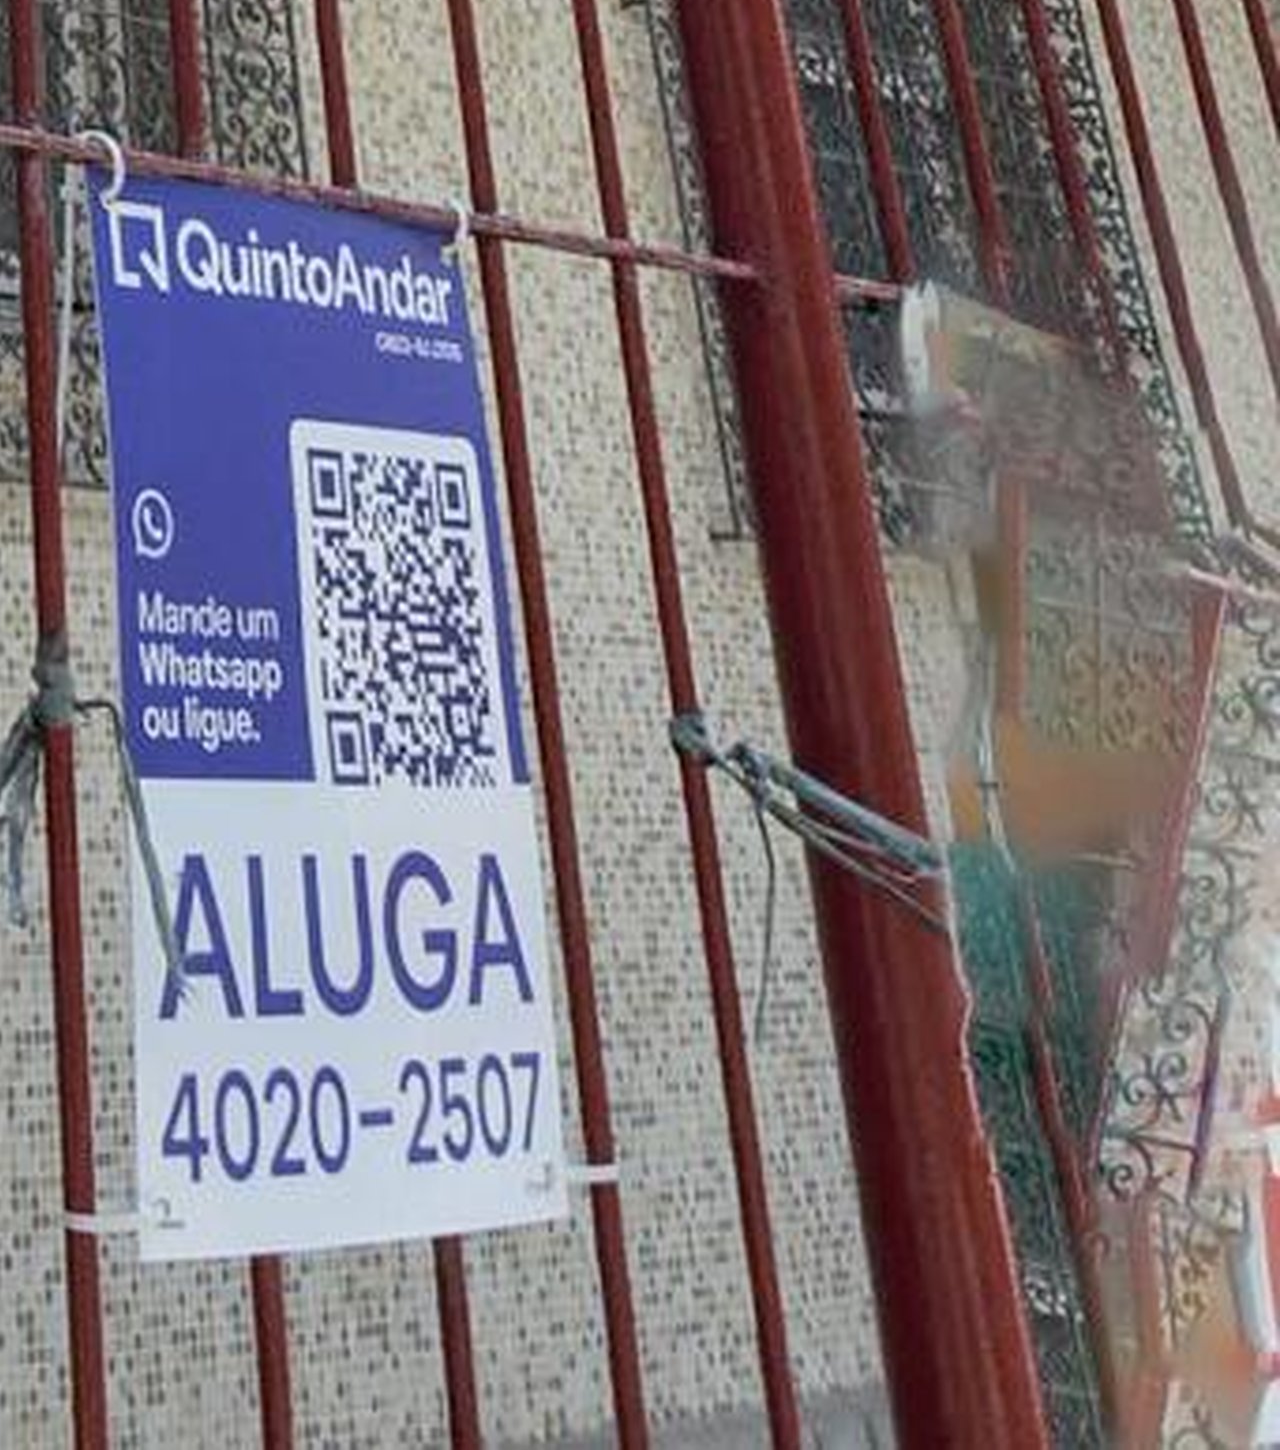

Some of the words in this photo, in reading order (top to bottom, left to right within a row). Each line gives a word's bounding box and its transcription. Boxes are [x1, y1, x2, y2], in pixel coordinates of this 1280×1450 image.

[176, 219, 452, 326] QuintoAndar
[138, 590, 233, 638] Mande
[236, 607, 281, 643] um
[138, 641, 283, 701] Whatsapp
[142, 705, 181, 740] ou
[183, 695, 262, 754] ligue.
[158, 850, 534, 1020] ALUGA
[161, 1051, 542, 1183] 4020-2507
